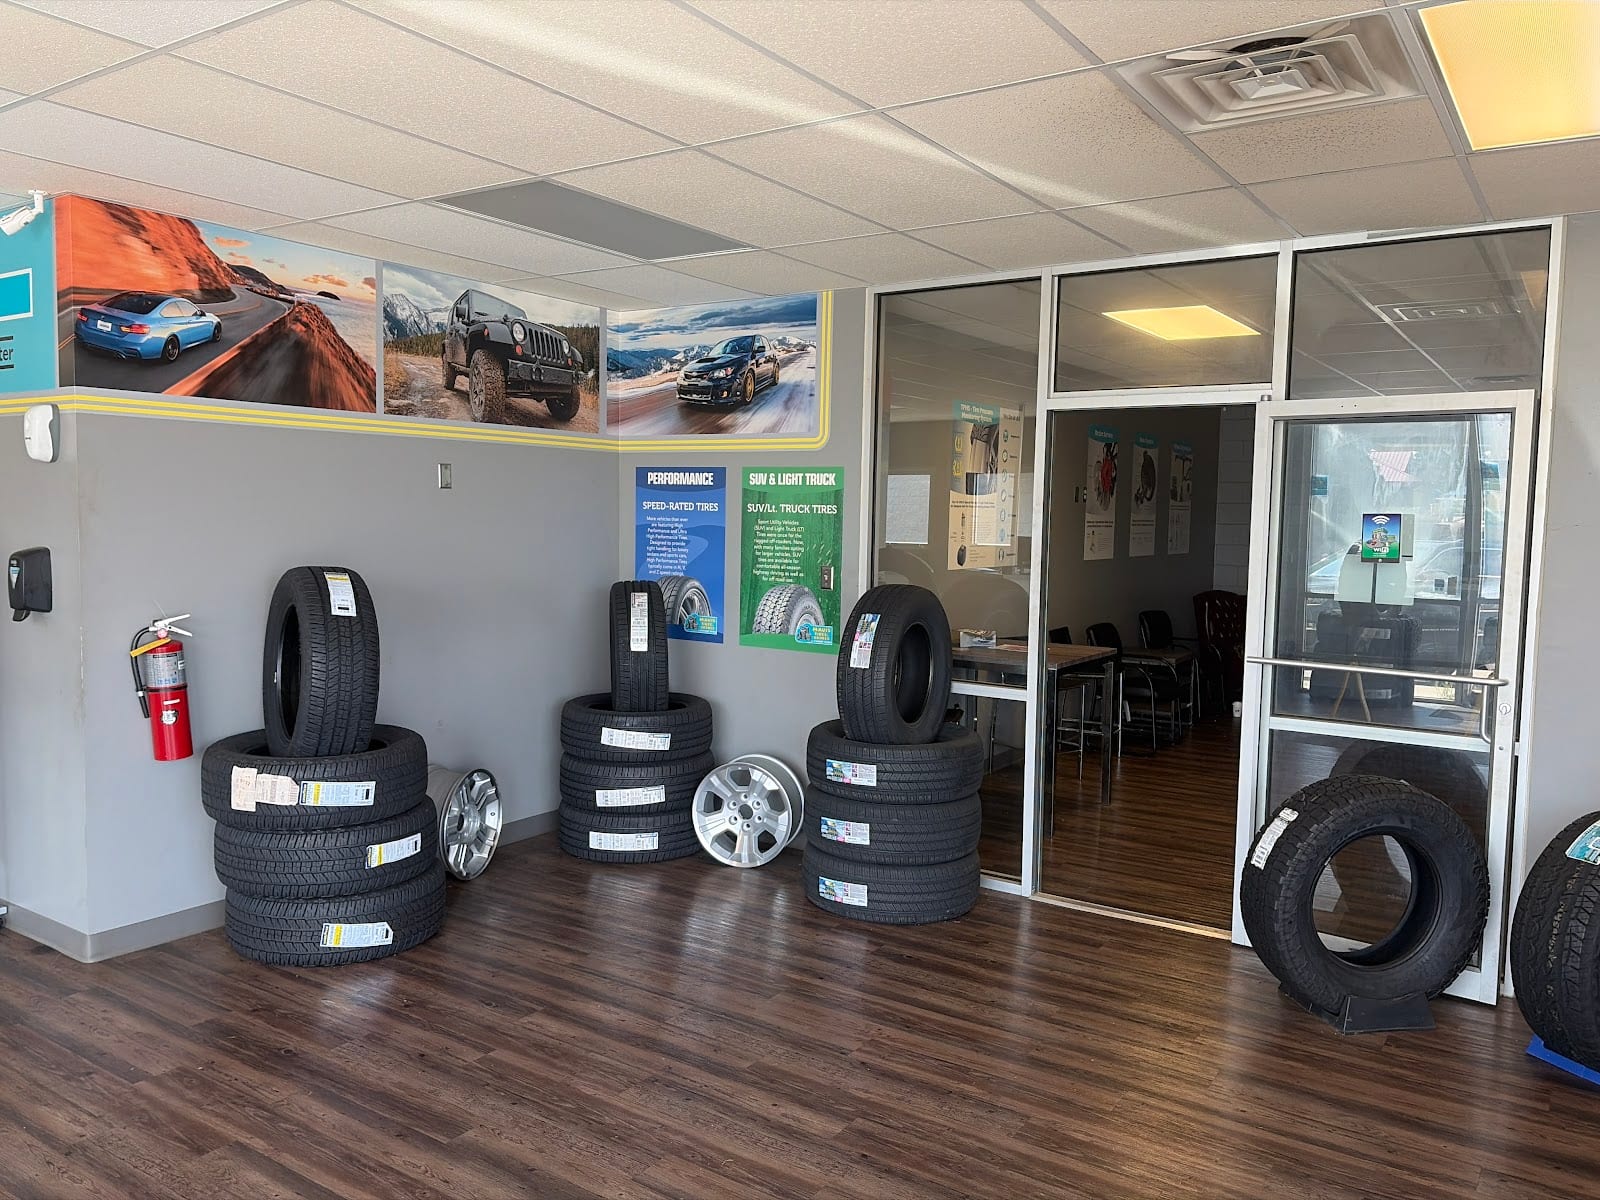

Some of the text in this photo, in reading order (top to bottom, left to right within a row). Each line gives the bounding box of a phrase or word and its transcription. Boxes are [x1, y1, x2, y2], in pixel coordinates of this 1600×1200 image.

[647, 472, 714, 486] PERFORMANCE
[749, 472, 836, 486] SUV & LIGHT TRUCK
[642, 501, 718, 512] SPEED-RATED TIRES
[747, 504, 837, 514] SUV/Lt. TRUCK TIRES
